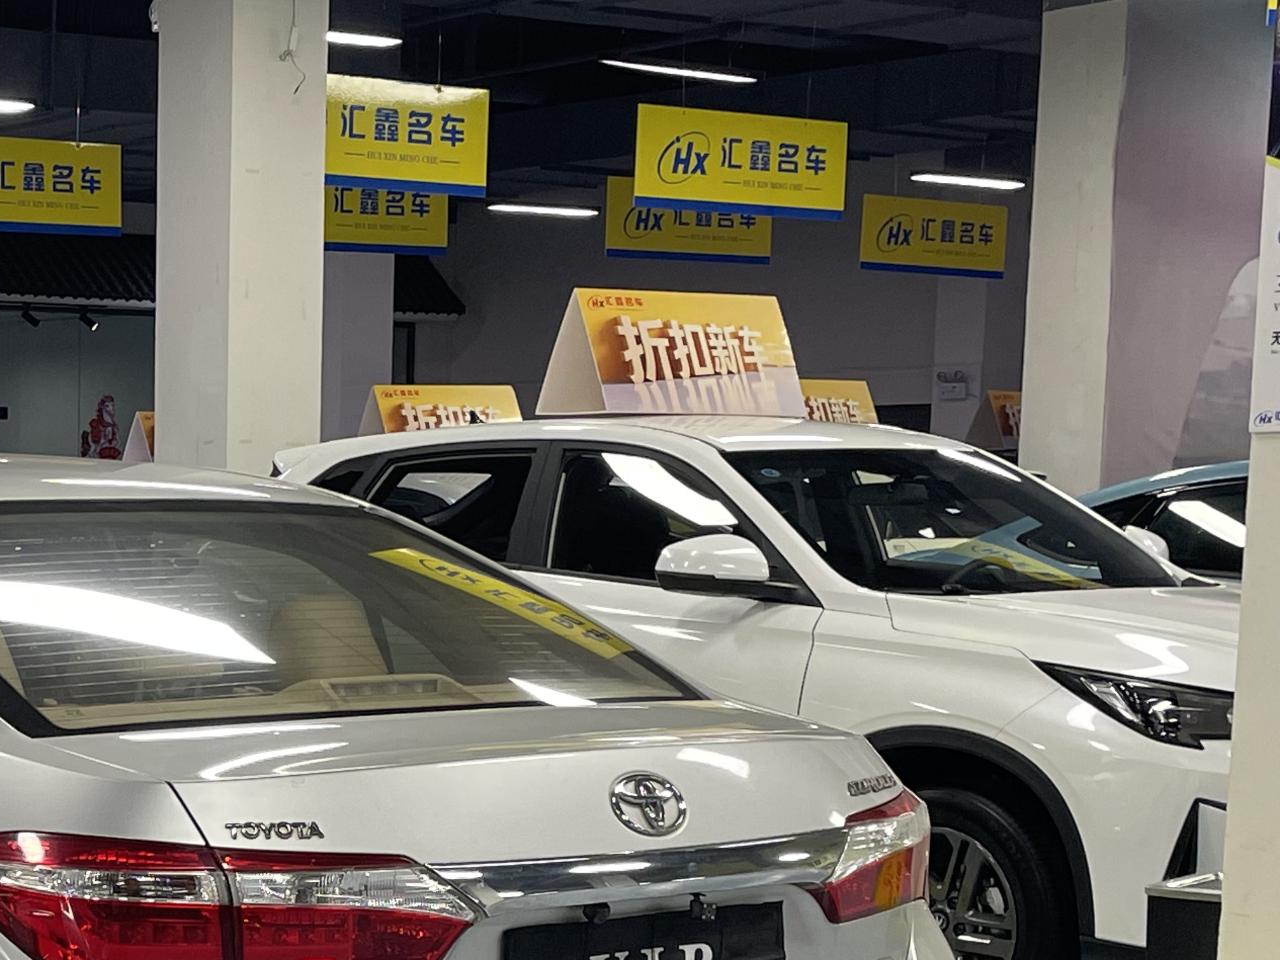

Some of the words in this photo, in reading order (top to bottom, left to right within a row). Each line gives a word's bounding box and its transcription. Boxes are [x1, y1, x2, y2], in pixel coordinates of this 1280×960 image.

[340, 104, 465, 147] 汇鑫名车
[672, 142, 709, 175] Hx
[722, 138, 827, 175] 汇鑫名车
[334, 187, 431, 217] 汇鑫名车
[617, 315, 766, 383] 折扣新车
[225, 821, 325, 840] TOYOTA
